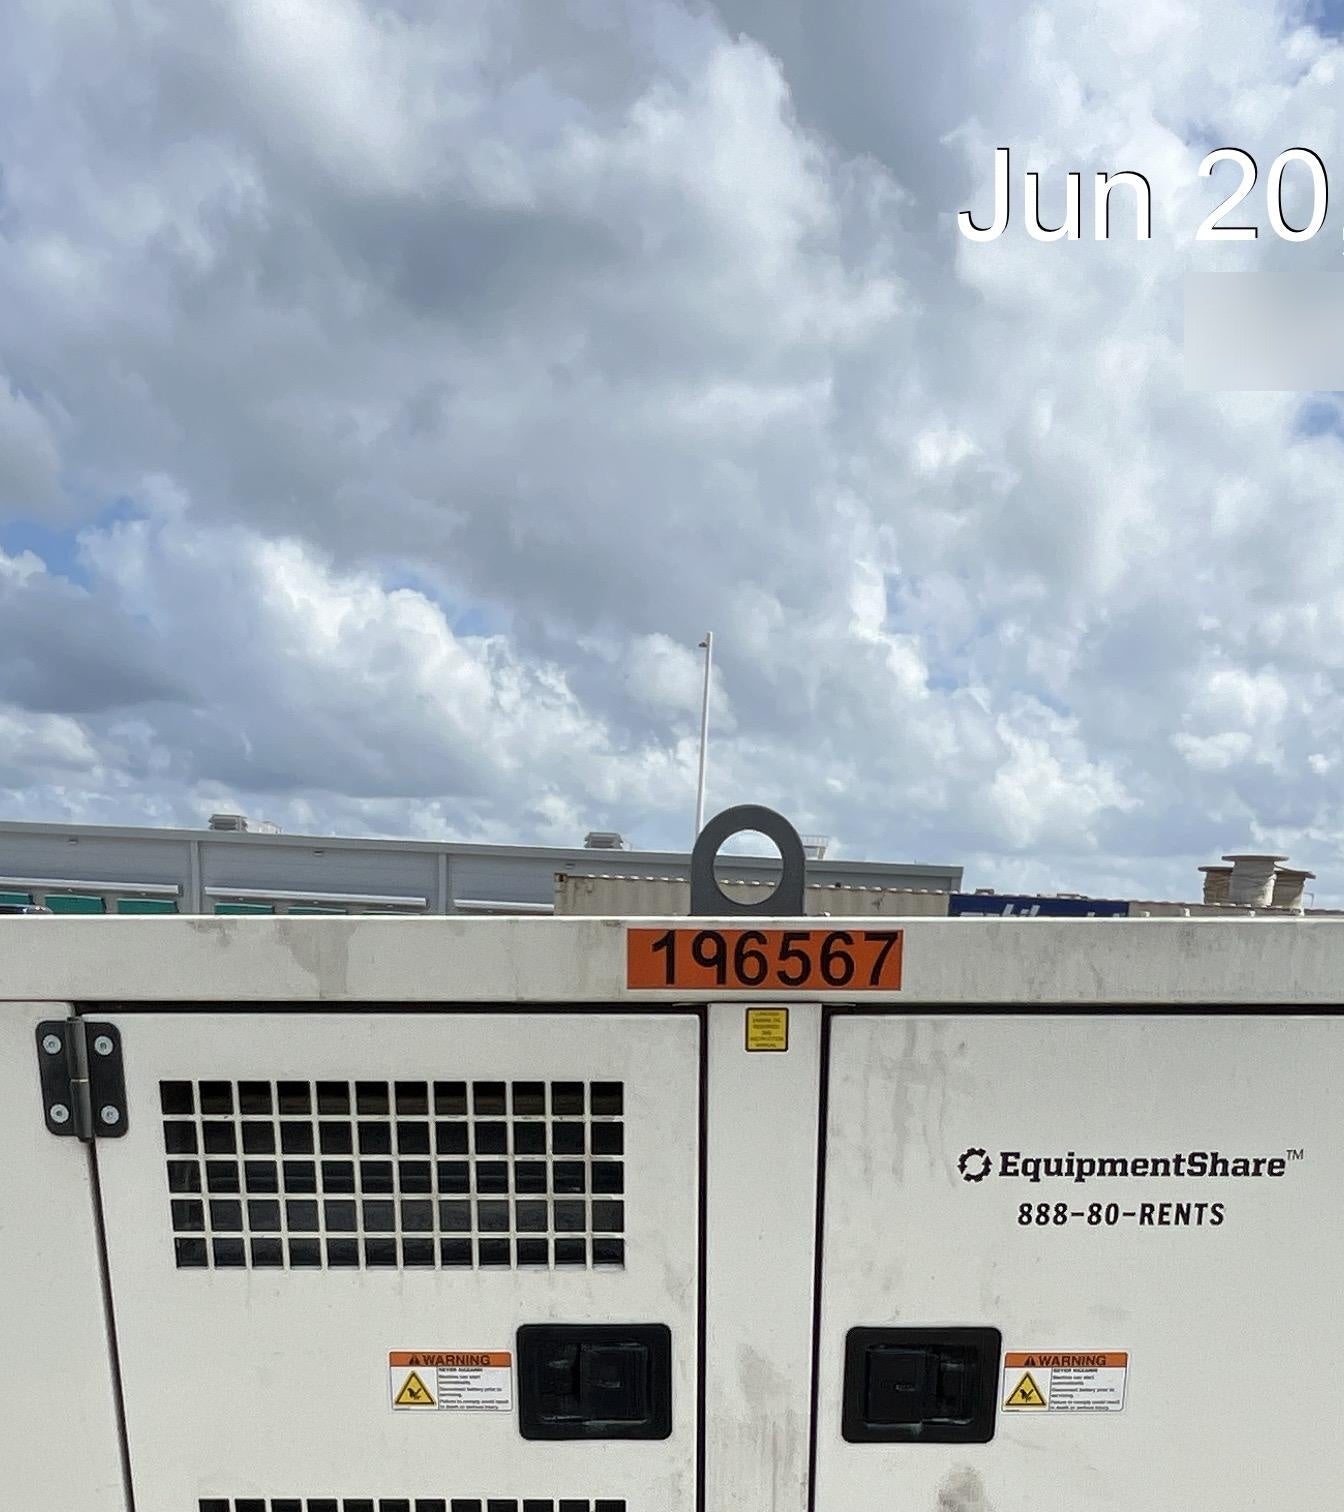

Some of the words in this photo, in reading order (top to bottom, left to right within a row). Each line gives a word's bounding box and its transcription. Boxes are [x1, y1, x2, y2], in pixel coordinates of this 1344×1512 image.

[651, 929, 899, 987] 196567
[1017, 1202, 1226, 1226] 888-80-RENTS
[424, 1354, 491, 1366] WARNING
[1037, 1355, 1107, 1367] WARNING
